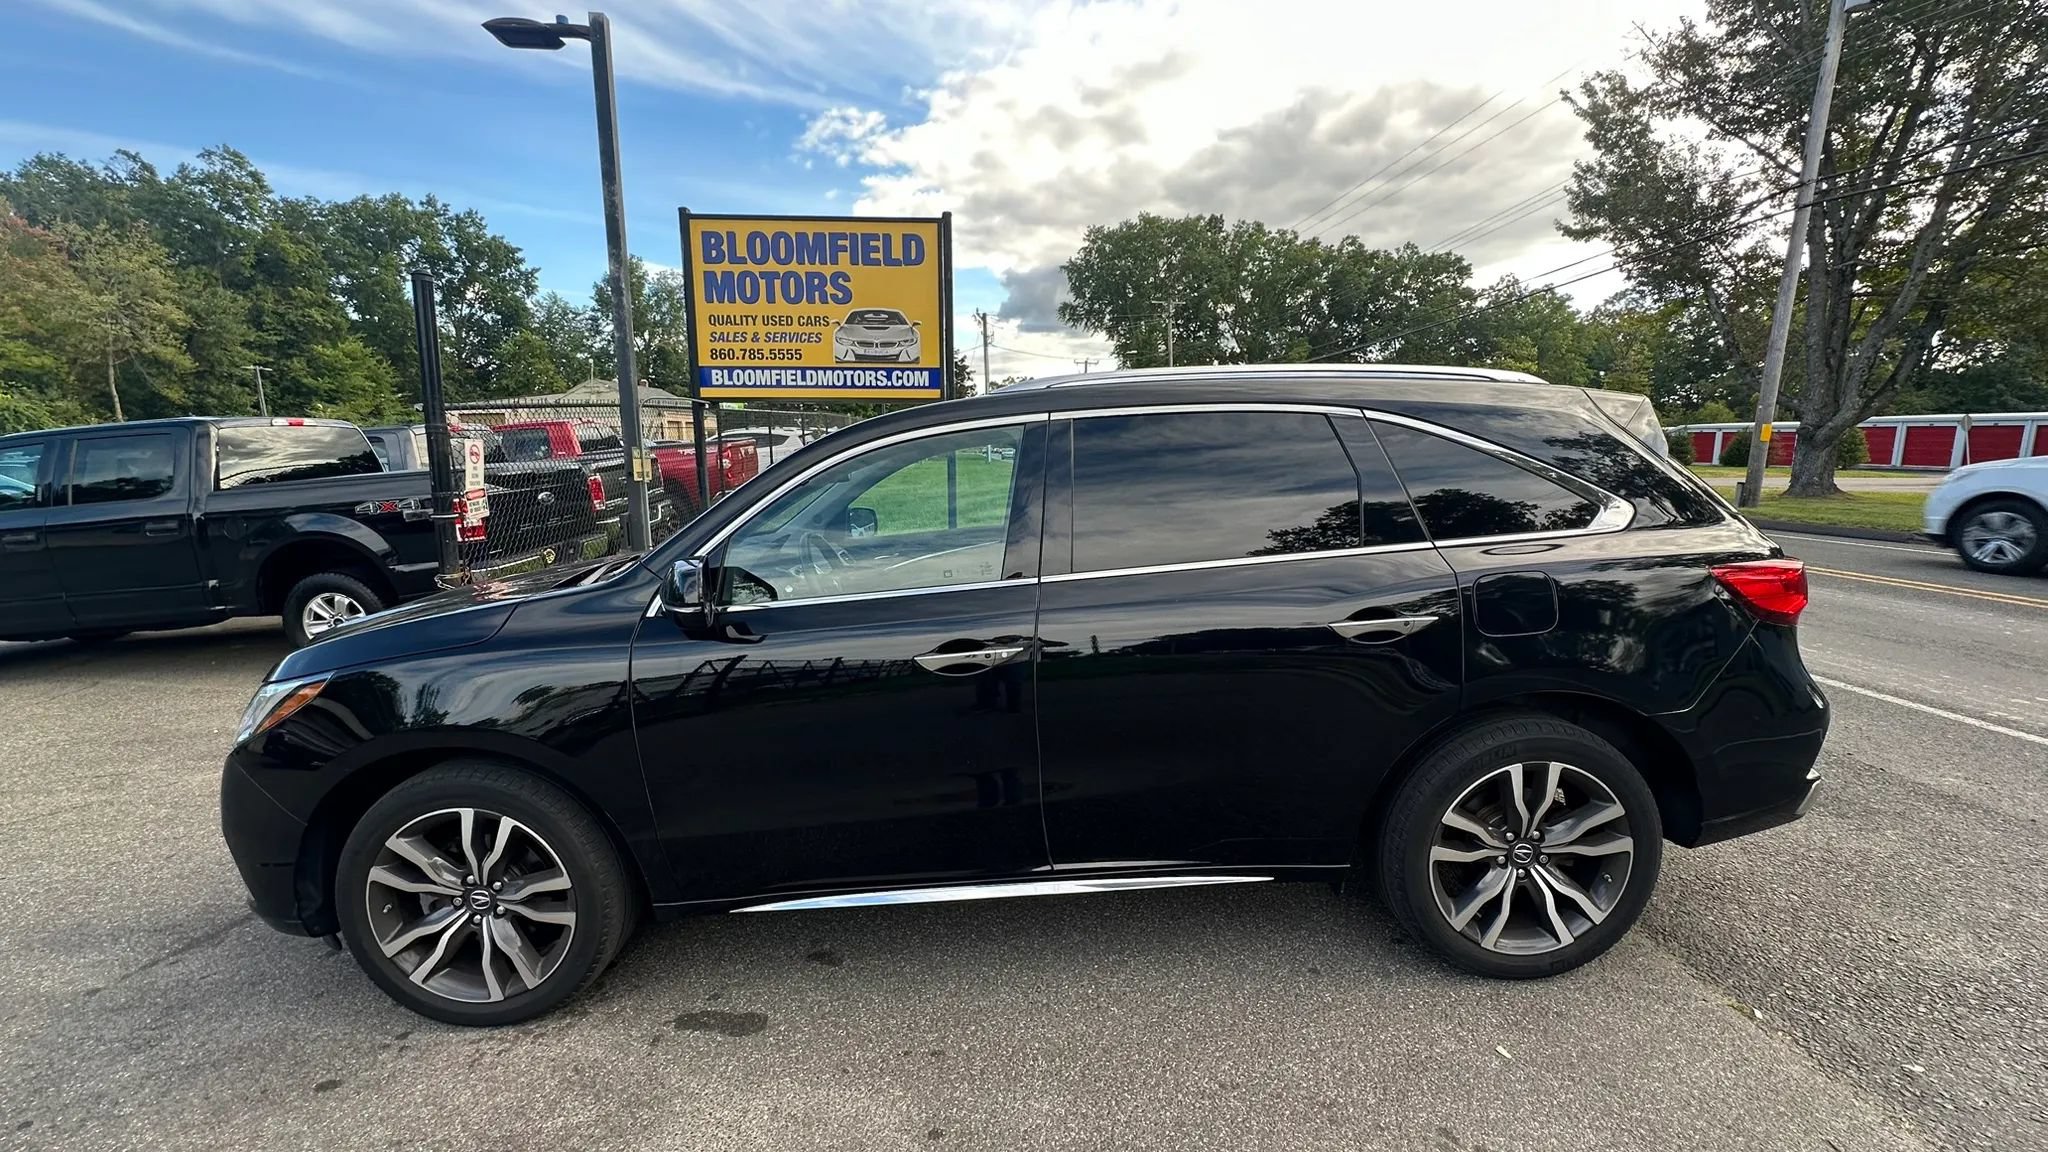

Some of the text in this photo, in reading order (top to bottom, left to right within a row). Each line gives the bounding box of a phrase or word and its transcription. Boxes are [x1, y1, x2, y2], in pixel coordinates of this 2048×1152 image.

[701, 231, 925, 267] BLOOMFIELD
[703, 271, 853, 305] MOTORS
[708, 314, 830, 327] QUALITY USED CARS
[709, 332, 822, 343] SALES & SERVICES
[710, 348, 803, 361] 860.785.5555
[711, 369, 930, 387] BLOOMFIELDMOTORS.COM
